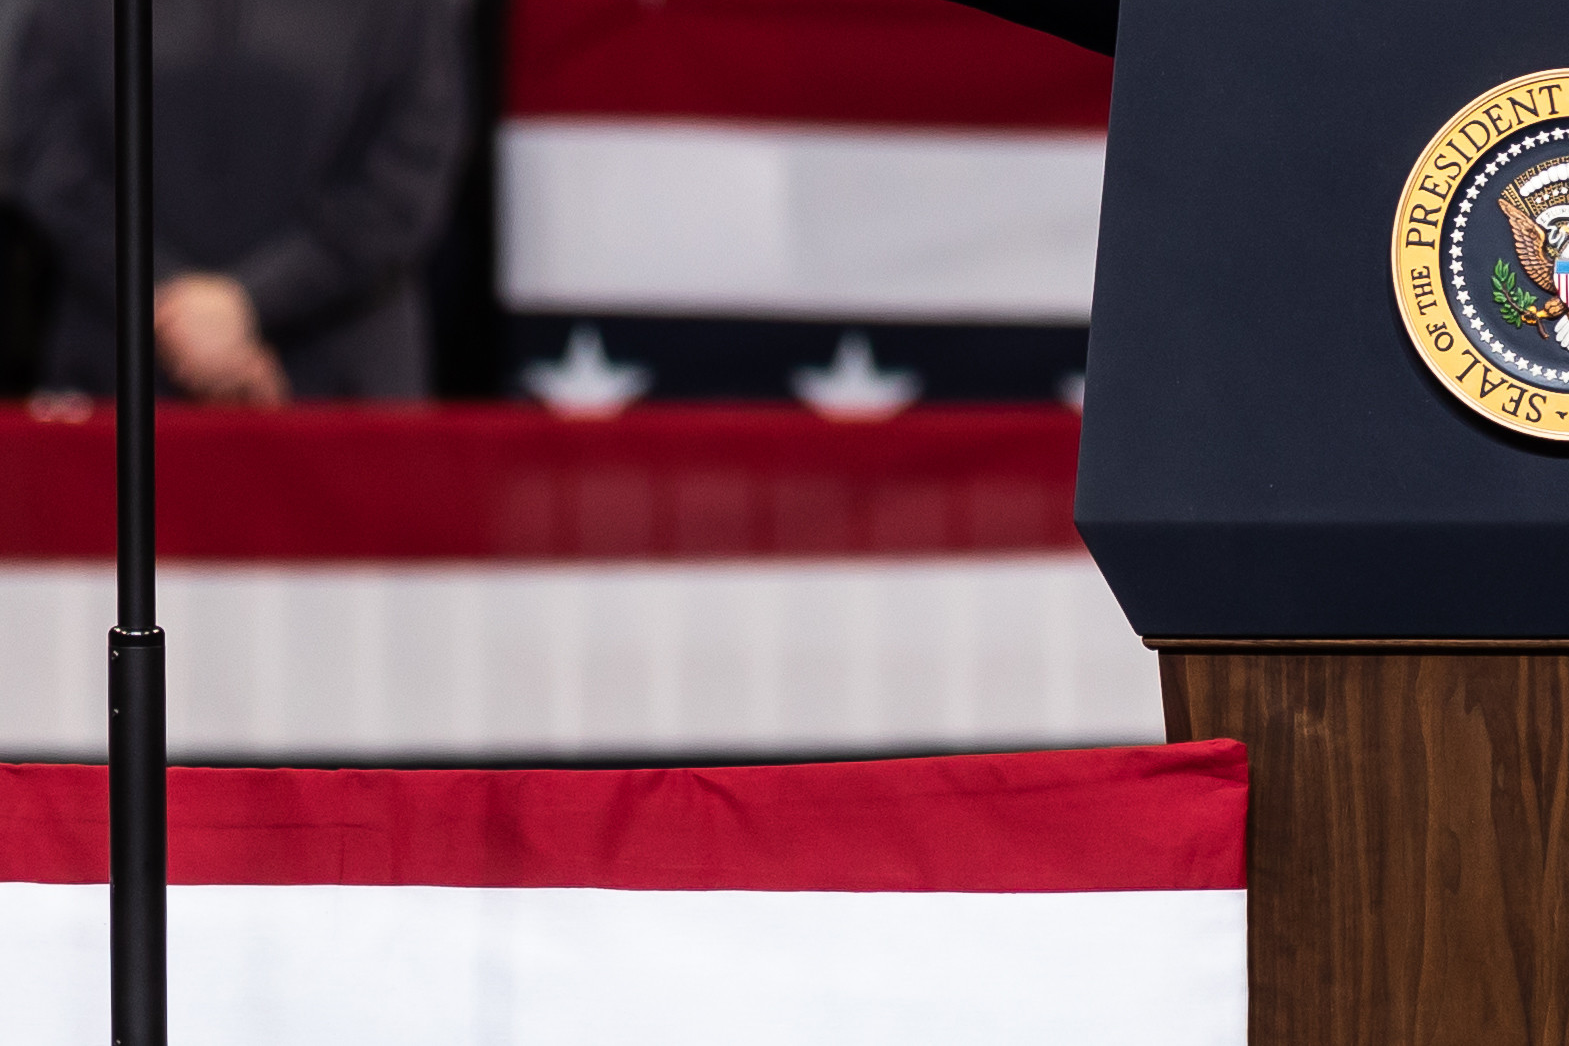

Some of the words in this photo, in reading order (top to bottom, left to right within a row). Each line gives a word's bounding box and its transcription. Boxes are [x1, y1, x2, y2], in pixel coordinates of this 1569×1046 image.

[1405, 83, 1563, 251] PRESIDENT
[1410, 265, 1438, 316] THE
[1426, 321, 1455, 352] OF
[1455, 348, 1548, 423] SEAL
